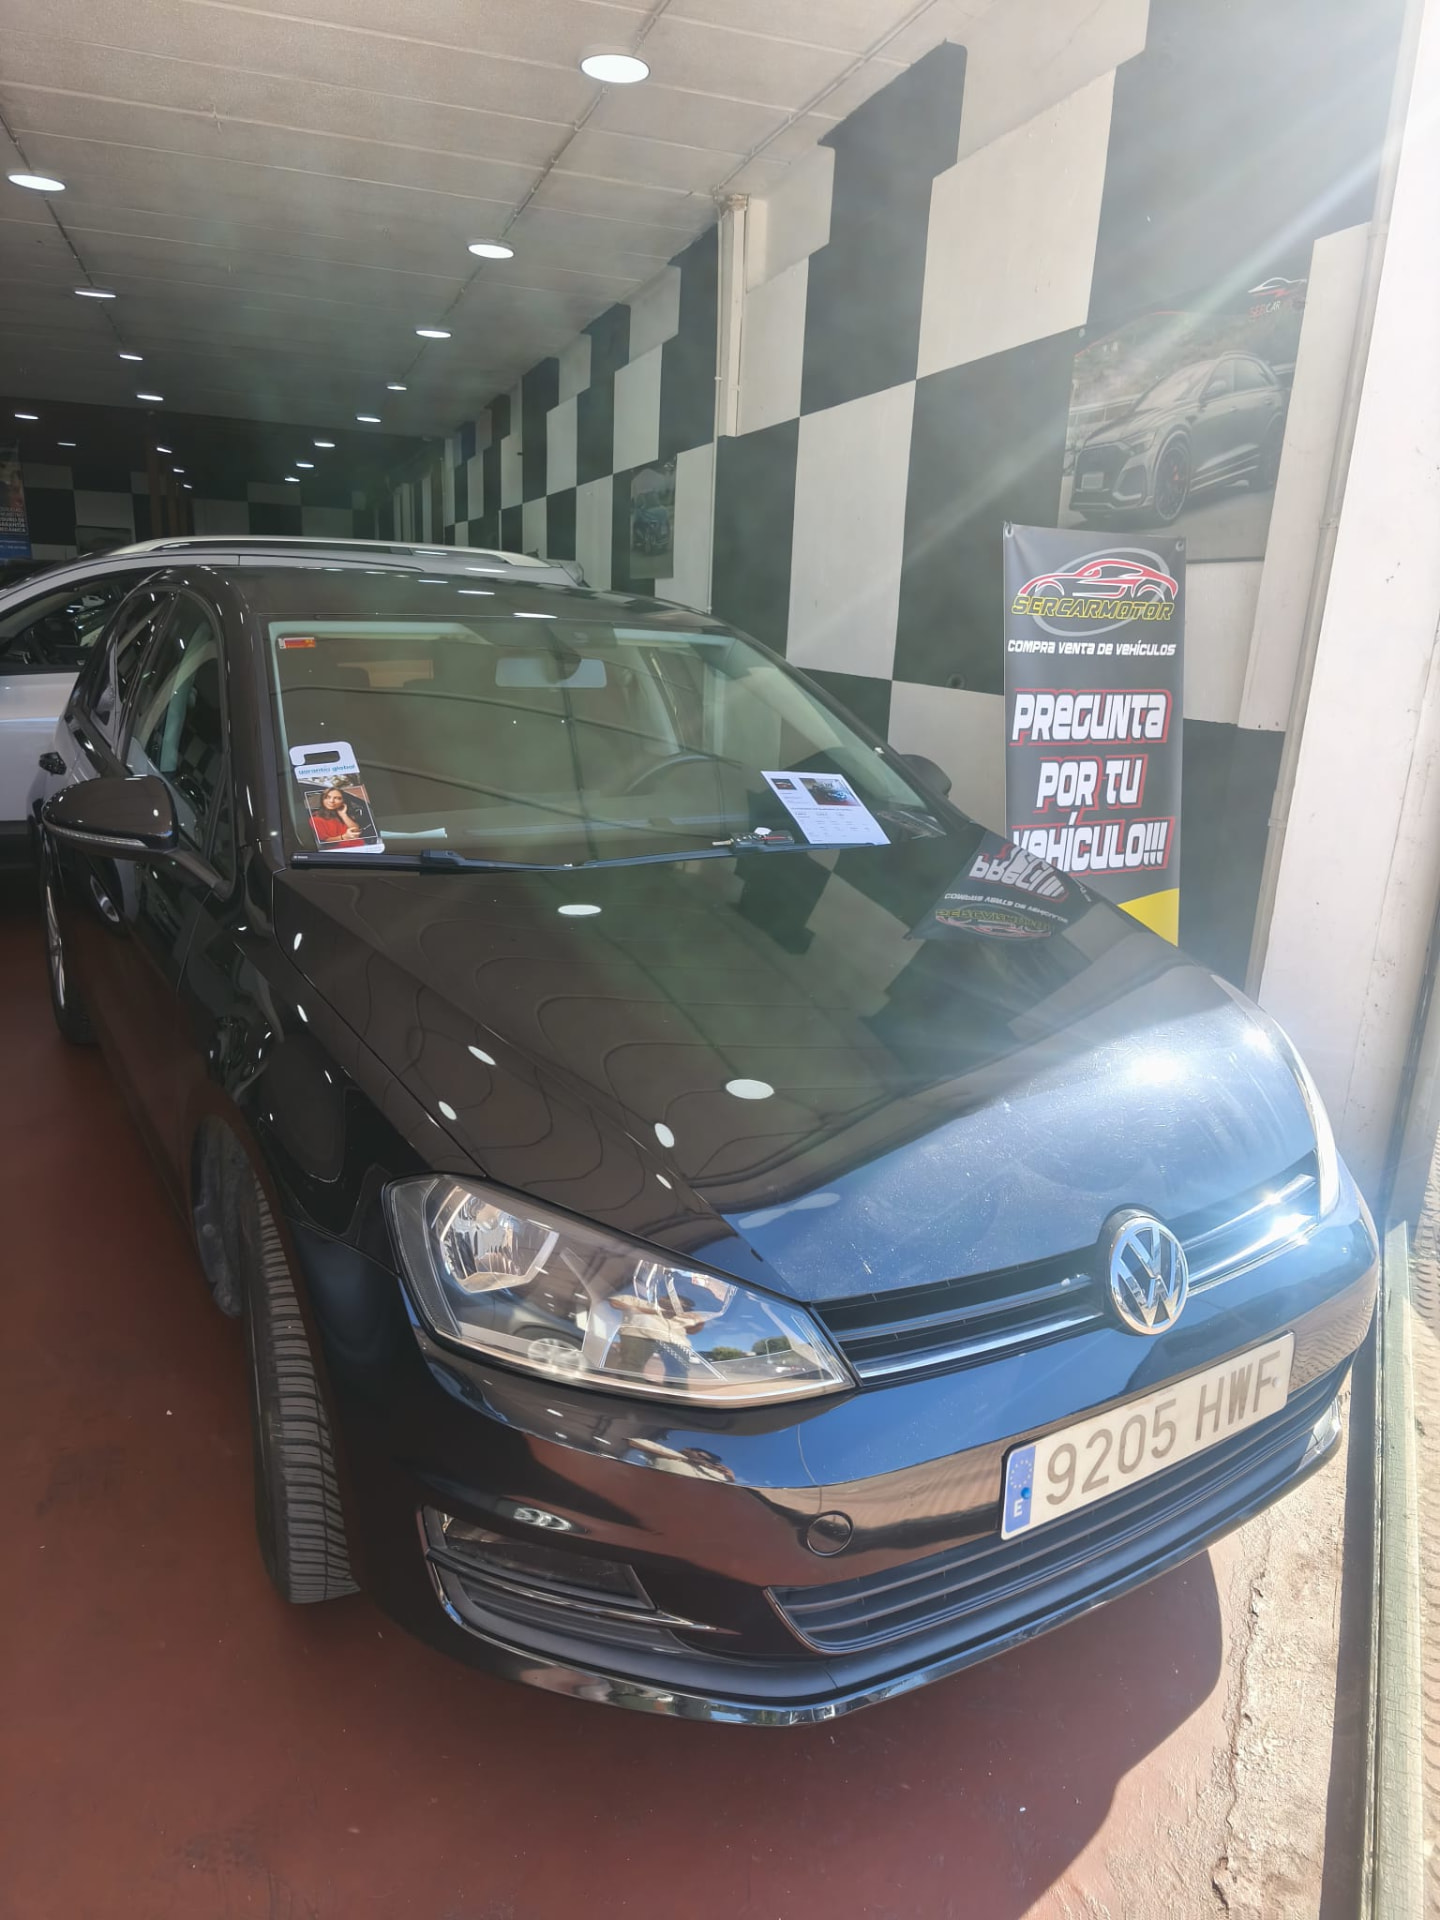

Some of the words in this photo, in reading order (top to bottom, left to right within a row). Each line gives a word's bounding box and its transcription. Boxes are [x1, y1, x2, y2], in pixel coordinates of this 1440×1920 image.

[1011, 596, 1175, 621] SERCARMOTOR
[1036, 758, 1099, 808] POR
[1105, 758, 1143, 804] TU
[1046, 1397, 1178, 1506] 9205
[1194, 1350, 1282, 1442] HWF
[1013, 1498, 1024, 1518] E
